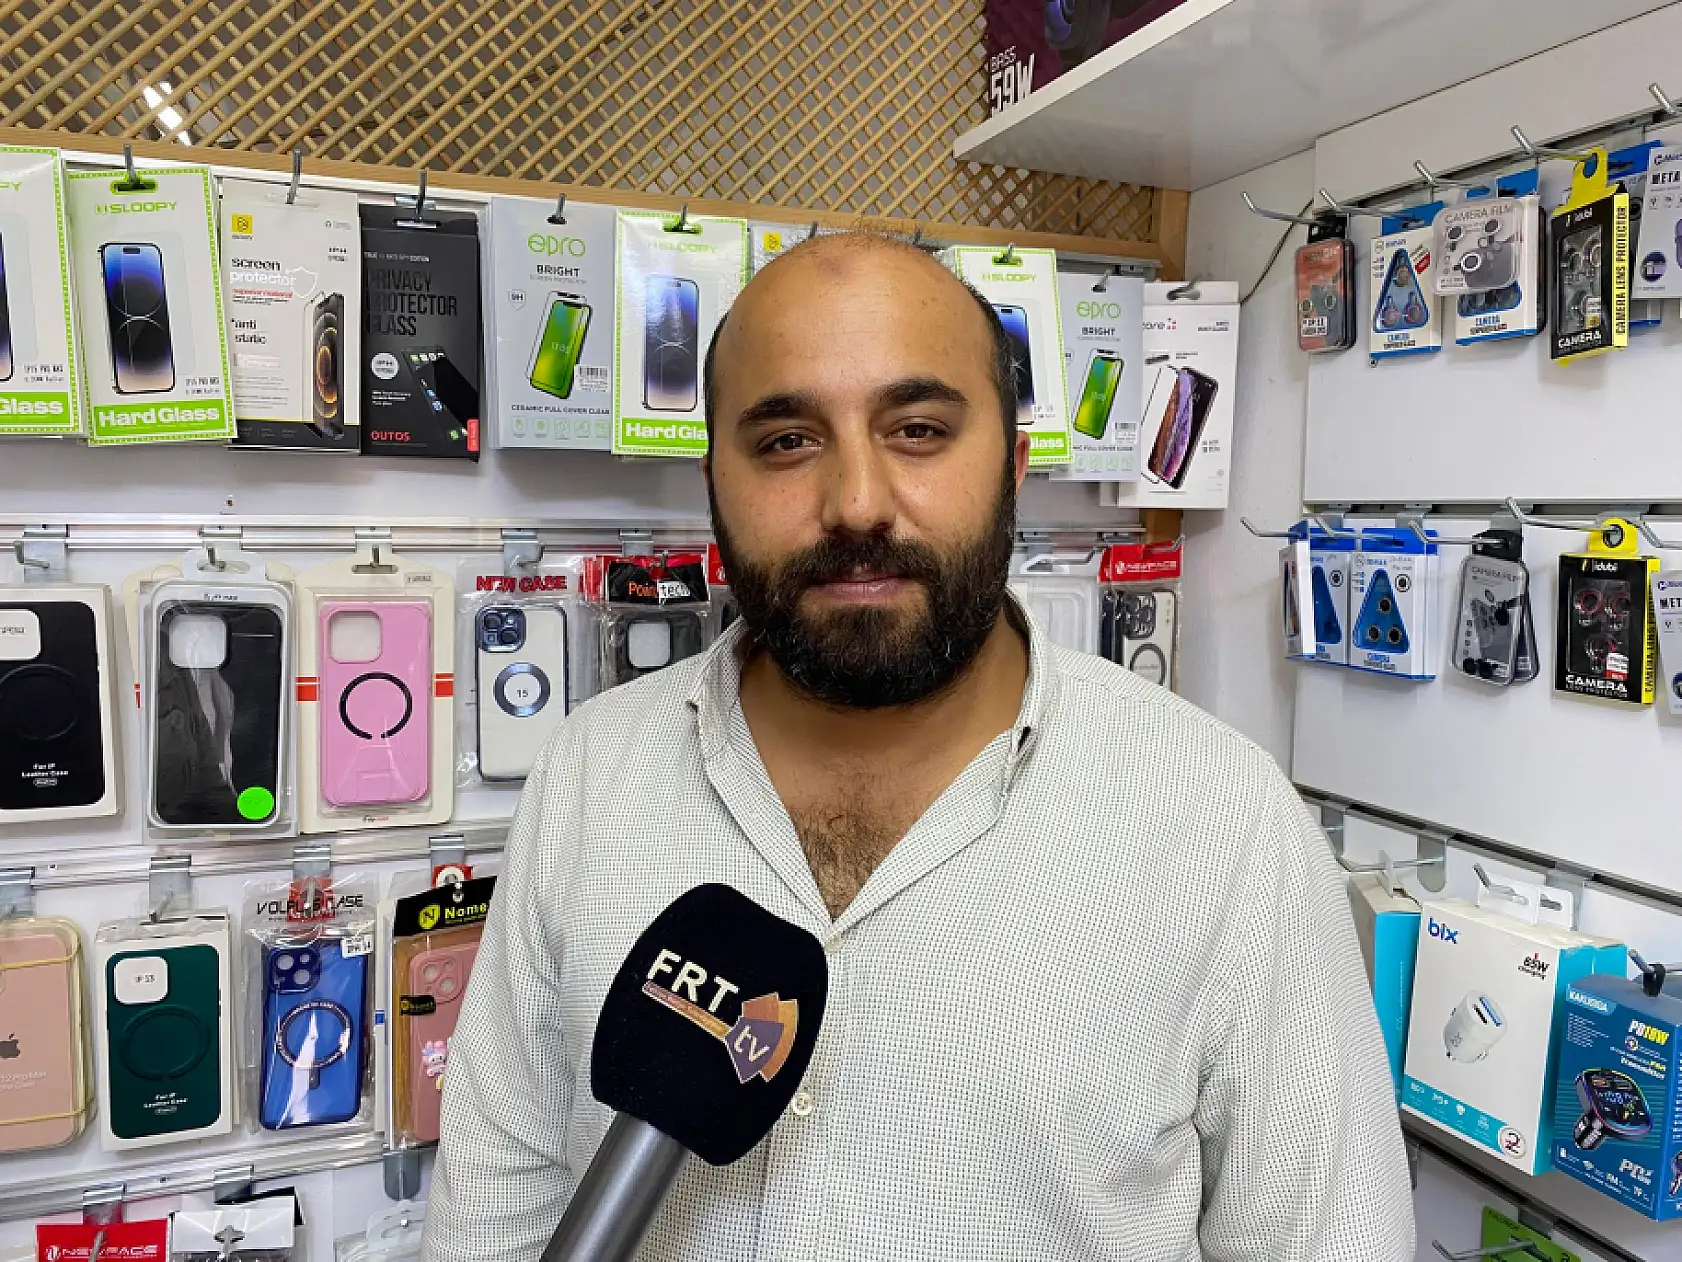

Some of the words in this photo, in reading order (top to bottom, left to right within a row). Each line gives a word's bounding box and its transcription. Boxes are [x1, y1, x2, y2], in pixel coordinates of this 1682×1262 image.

[109, 201, 176, 214] SLOOPY
[1615, 206, 1627, 263] PROTECTOR
[527, 233, 587, 257] epro
[536, 264, 581, 277] BRIGHT
[1615, 266, 1626, 290] LENS
[1075, 301, 1122, 321] epro
[1615, 292, 1626, 335] CAMERA
[1557, 330, 1602, 349] CAMERA
[98, 408, 157, 428] Hard
[157, 406, 220, 422] Glass
[625, 422, 677, 439] Hard
[678, 424, 708, 440] Gla
[1030, 435, 1065, 449] lass
[476, 576, 518, 592] NEW
[518, 576, 568, 592] CASE
[516, 687, 529, 698] 15
[1566, 674, 1628, 692] CAMERA
[1428, 916, 1459, 944] bix
[646, 948, 739, 1013] FRT
[733, 1023, 770, 1063] tv
